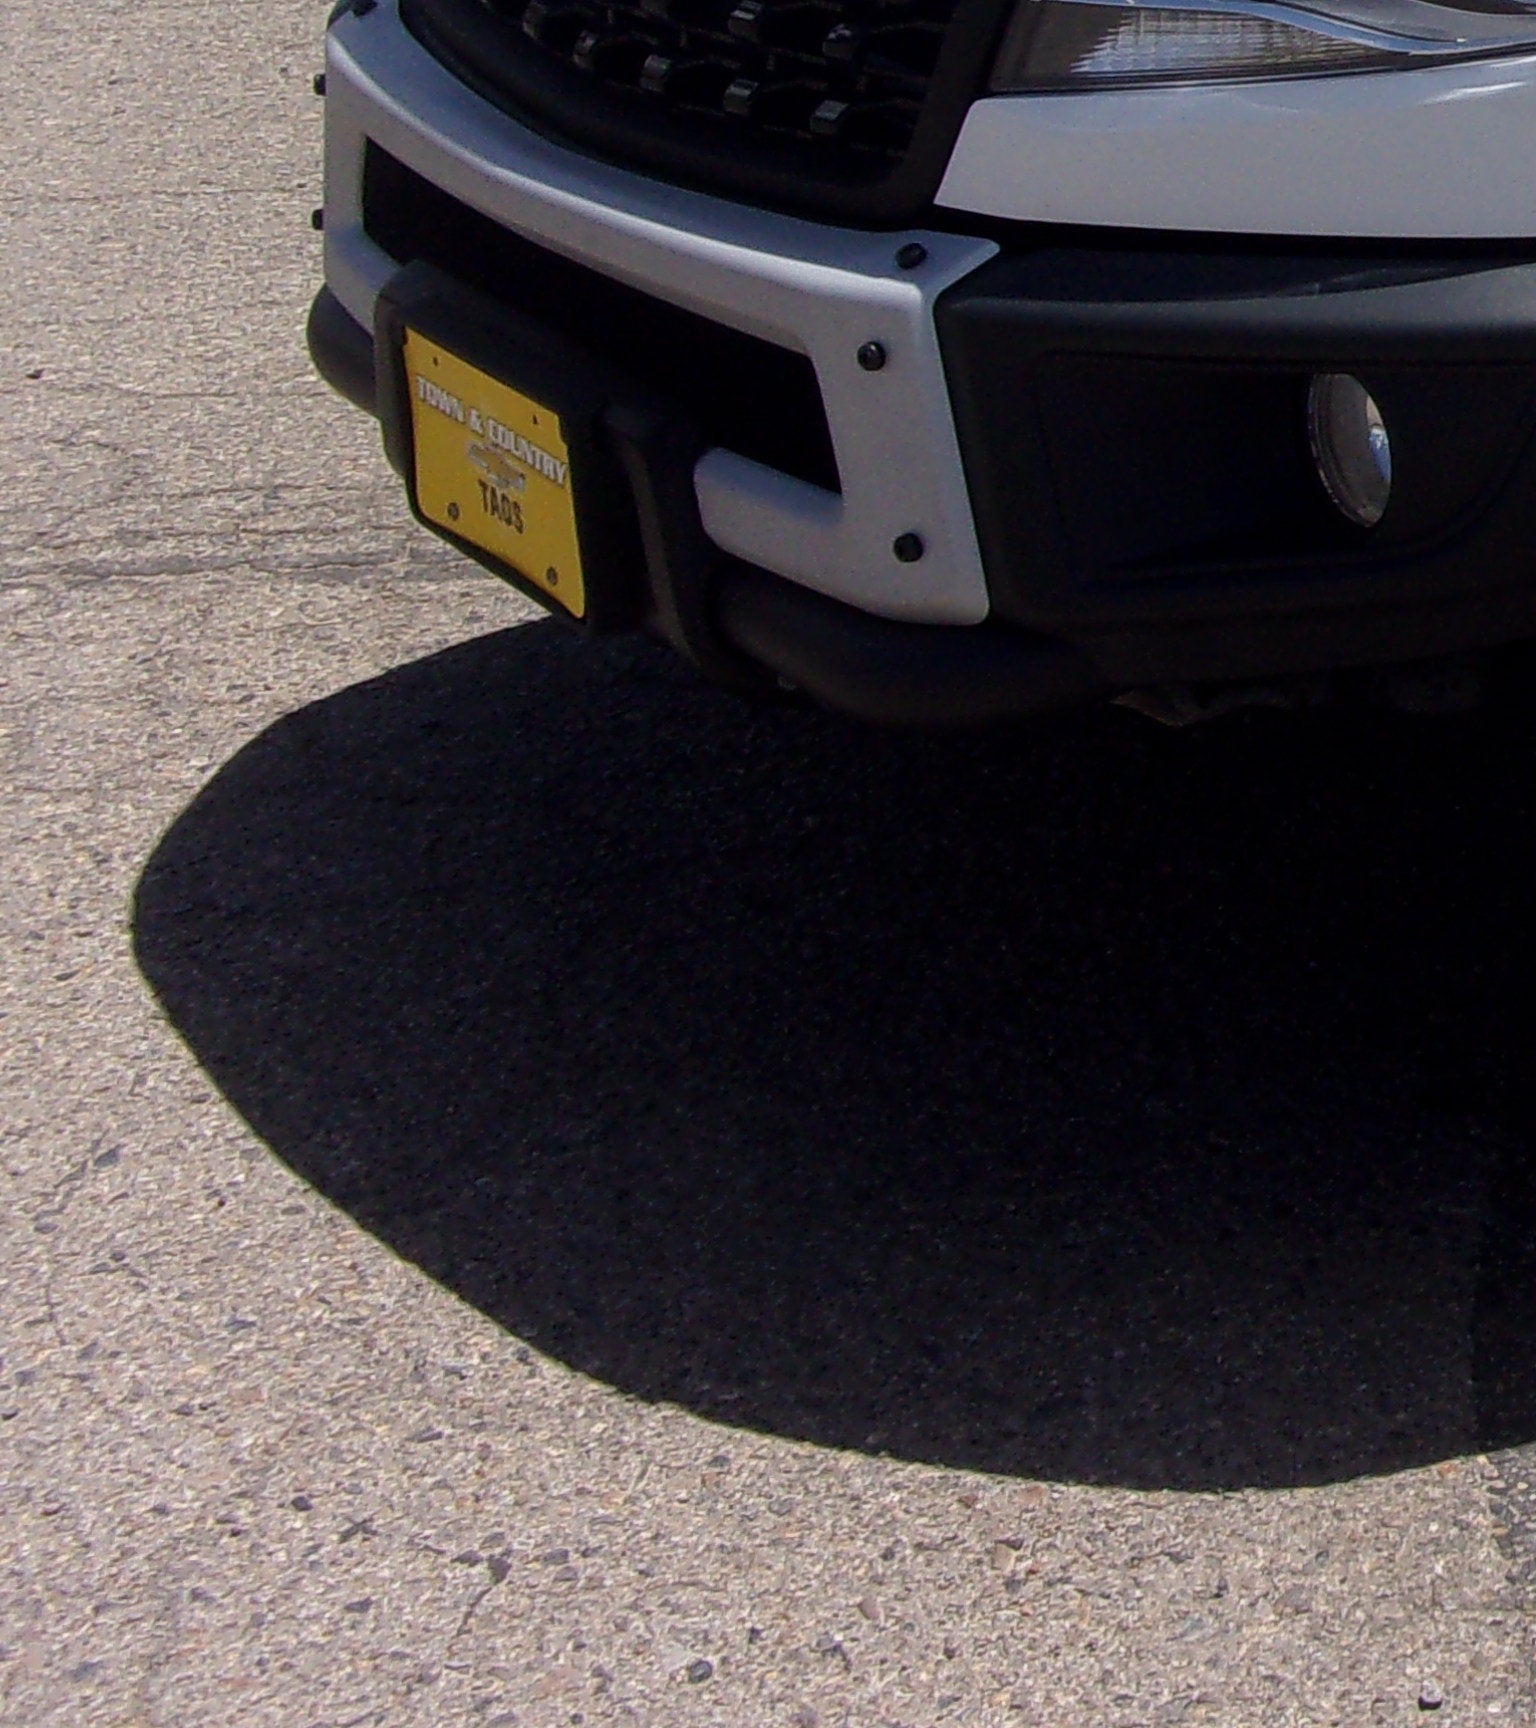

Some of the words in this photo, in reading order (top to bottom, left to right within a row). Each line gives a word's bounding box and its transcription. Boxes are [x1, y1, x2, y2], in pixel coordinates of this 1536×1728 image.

[416, 375, 464, 423] TOWN
[468, 407, 484, 435] &
[487, 416, 568, 486] COUNTRY
[477, 478, 525, 535] TAOS
